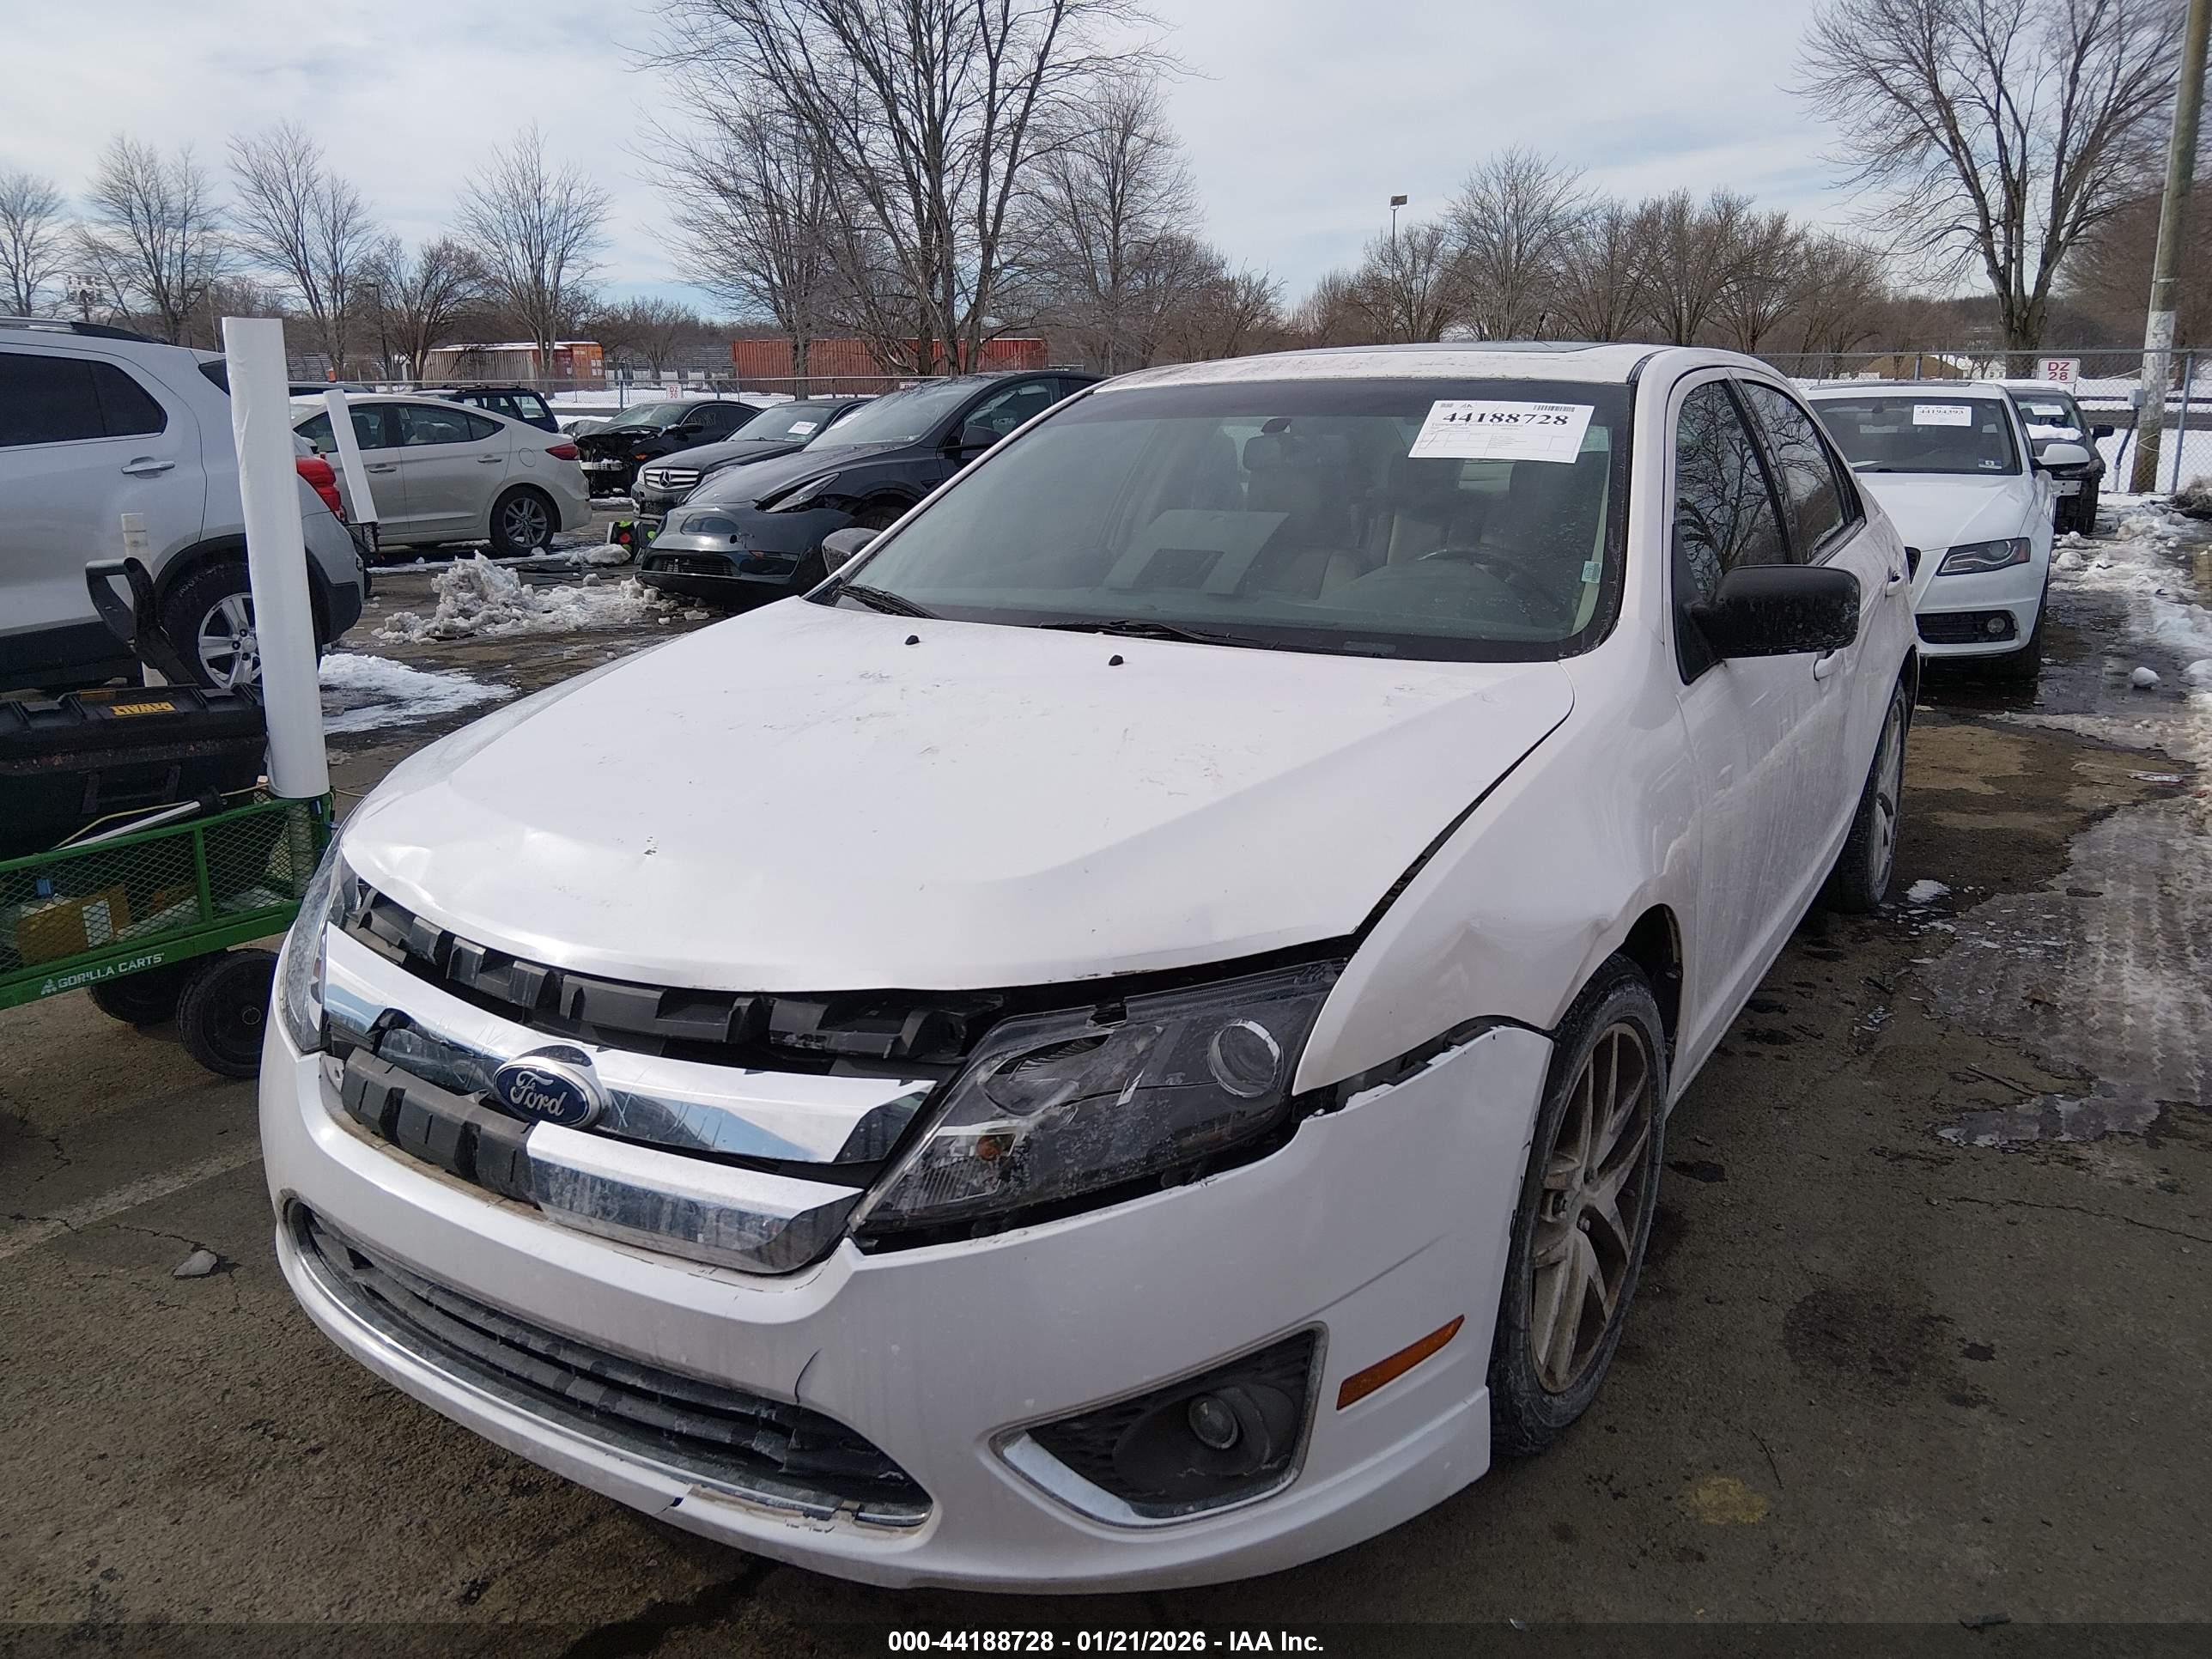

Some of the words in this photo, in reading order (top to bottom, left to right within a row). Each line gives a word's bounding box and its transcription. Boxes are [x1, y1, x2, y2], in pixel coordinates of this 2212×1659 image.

[2048, 362, 2070, 371] DZ
[2048, 372, 2068, 380] 28
[1443, 411, 1570, 426] 44188728
[58, 966, 115, 988] GORILLA
[118, 953, 162, 973] CARTS
[509, 1070, 568, 1116] Ford
